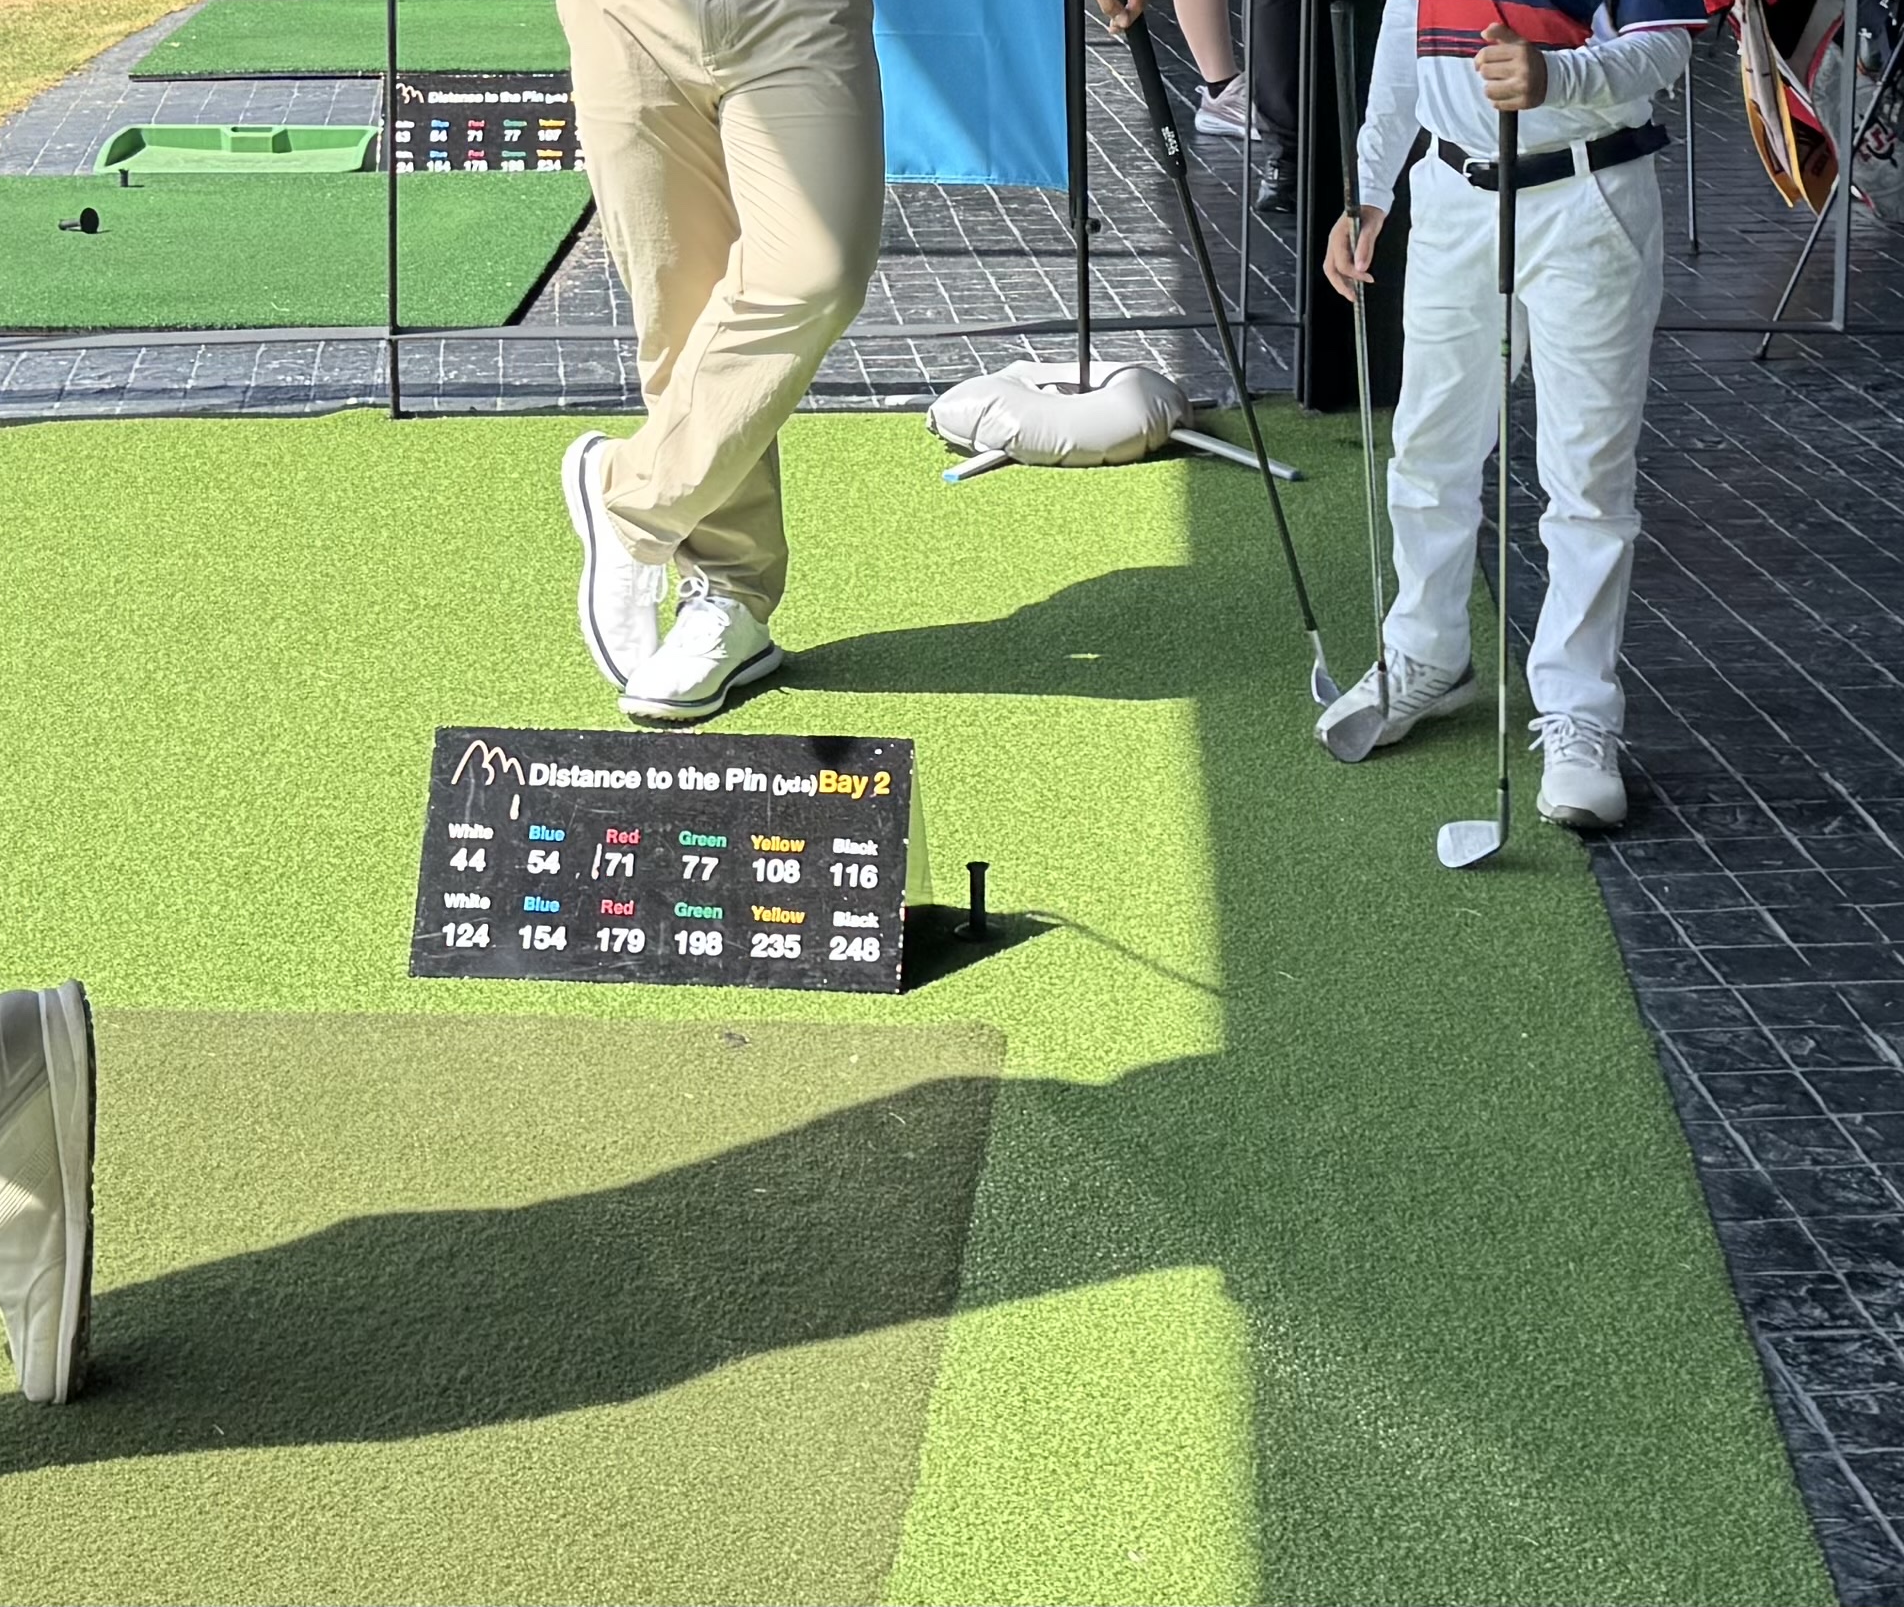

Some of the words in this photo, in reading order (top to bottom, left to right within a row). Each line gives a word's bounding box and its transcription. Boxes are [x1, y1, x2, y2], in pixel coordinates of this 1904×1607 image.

[528, 762, 642, 790] Distance
[645, 766, 674, 791] to
[677, 765, 721, 792] the
[725, 766, 768, 792] Pin
[771, 773, 818, 798] (yds)
[818, 769, 869, 800] Bay
[873, 770, 891, 794] 2
[448, 822, 495, 841] White
[528, 823, 566, 843] Blue
[605, 828, 641, 846] Red
[678, 830, 728, 852] Green
[750, 834, 806, 854] Yellow
[832, 837, 879, 857] Black
[449, 847, 487, 873] 44
[525, 849, 561, 875] 54
[604, 851, 635, 878] 71
[681, 854, 719, 883] 77
[751, 857, 801, 885] 108
[829, 860, 879, 889] 116
[443, 892, 491, 913] White
[523, 895, 561, 913] Blue
[600, 898, 635, 918] Red
[674, 900, 723, 921] Green
[750, 905, 806, 926] Yellow
[832, 908, 880, 929] Black
[441, 922, 491, 949] 124
[518, 924, 568, 951] 154
[595, 927, 646, 954] 179
[673, 929, 724, 957] 198
[750, 934, 803, 960] 235
[828, 934, 882, 963] 248
